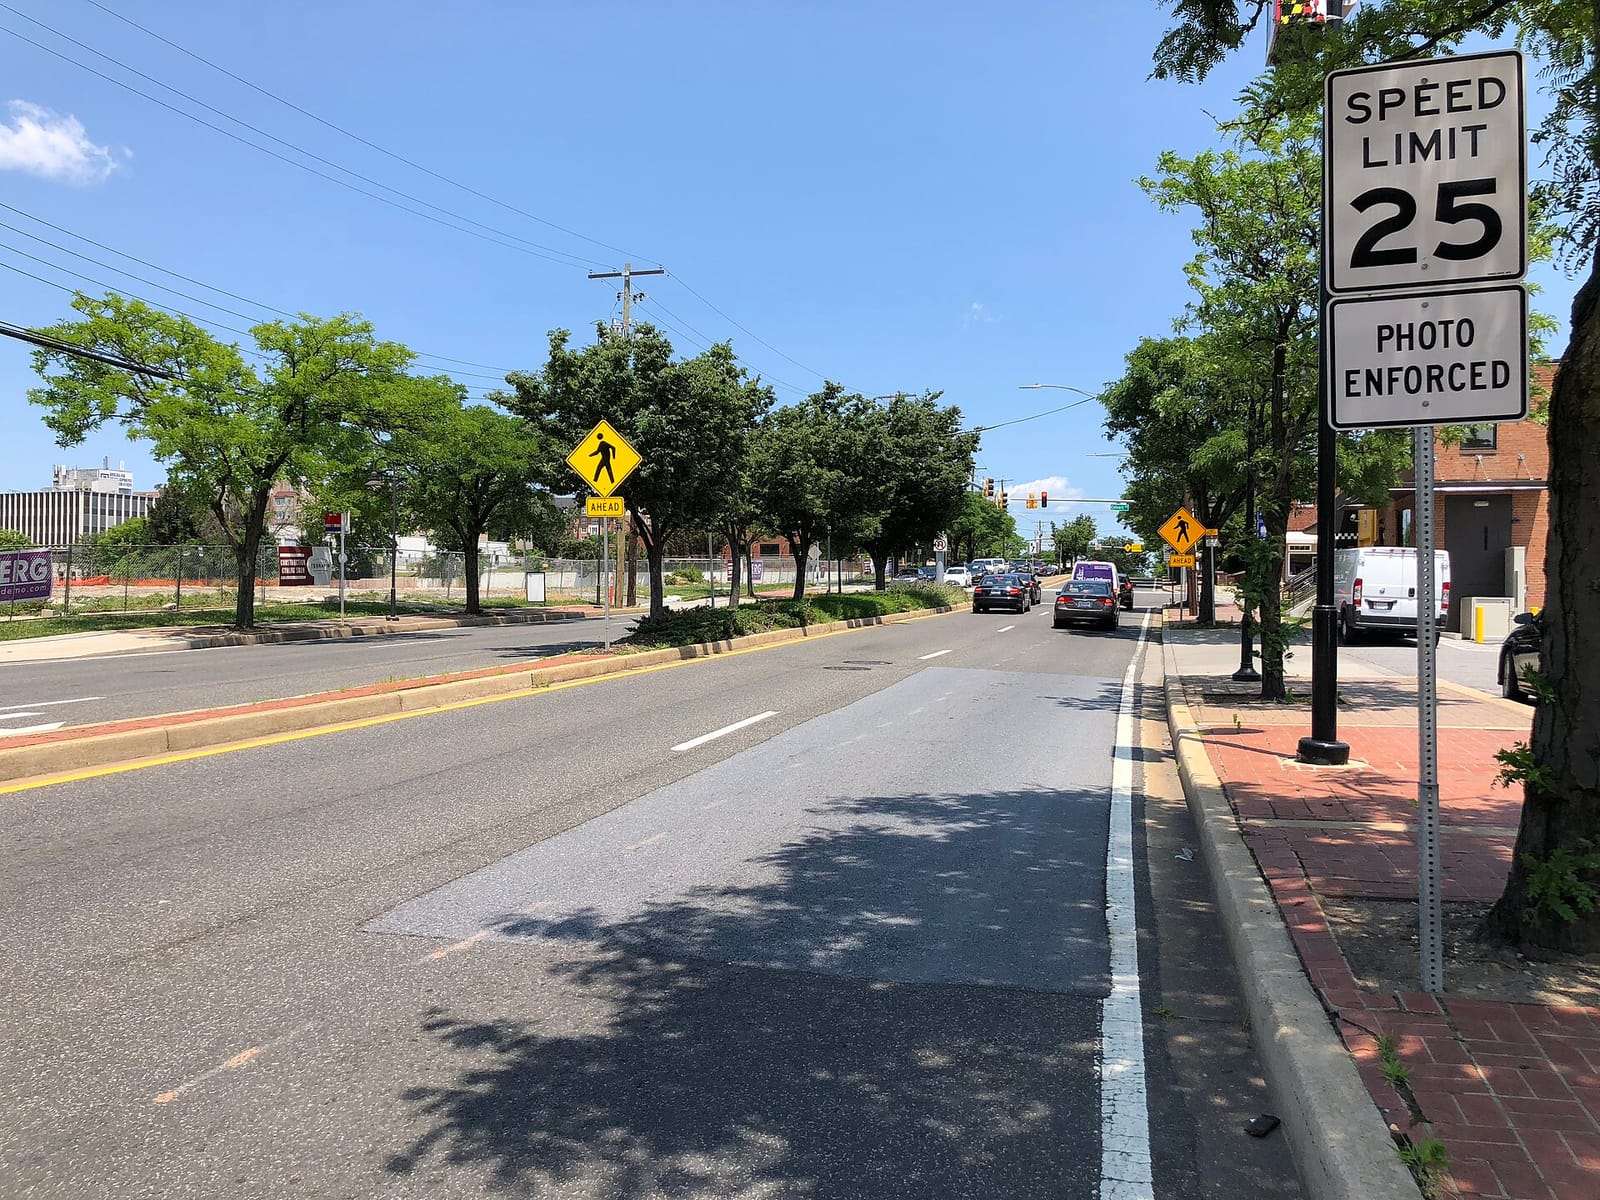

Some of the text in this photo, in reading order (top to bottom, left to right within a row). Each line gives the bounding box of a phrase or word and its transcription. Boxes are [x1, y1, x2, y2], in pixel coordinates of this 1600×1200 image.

[1345, 77, 1506, 124] SPEED
[1363, 124, 1487, 168] LIMIT
[1350, 178, 1502, 268] 25
[1377, 318, 1474, 353] PHOTO
[1345, 360, 1510, 398] ENFORCED
[591, 502, 619, 512] AHEAD
